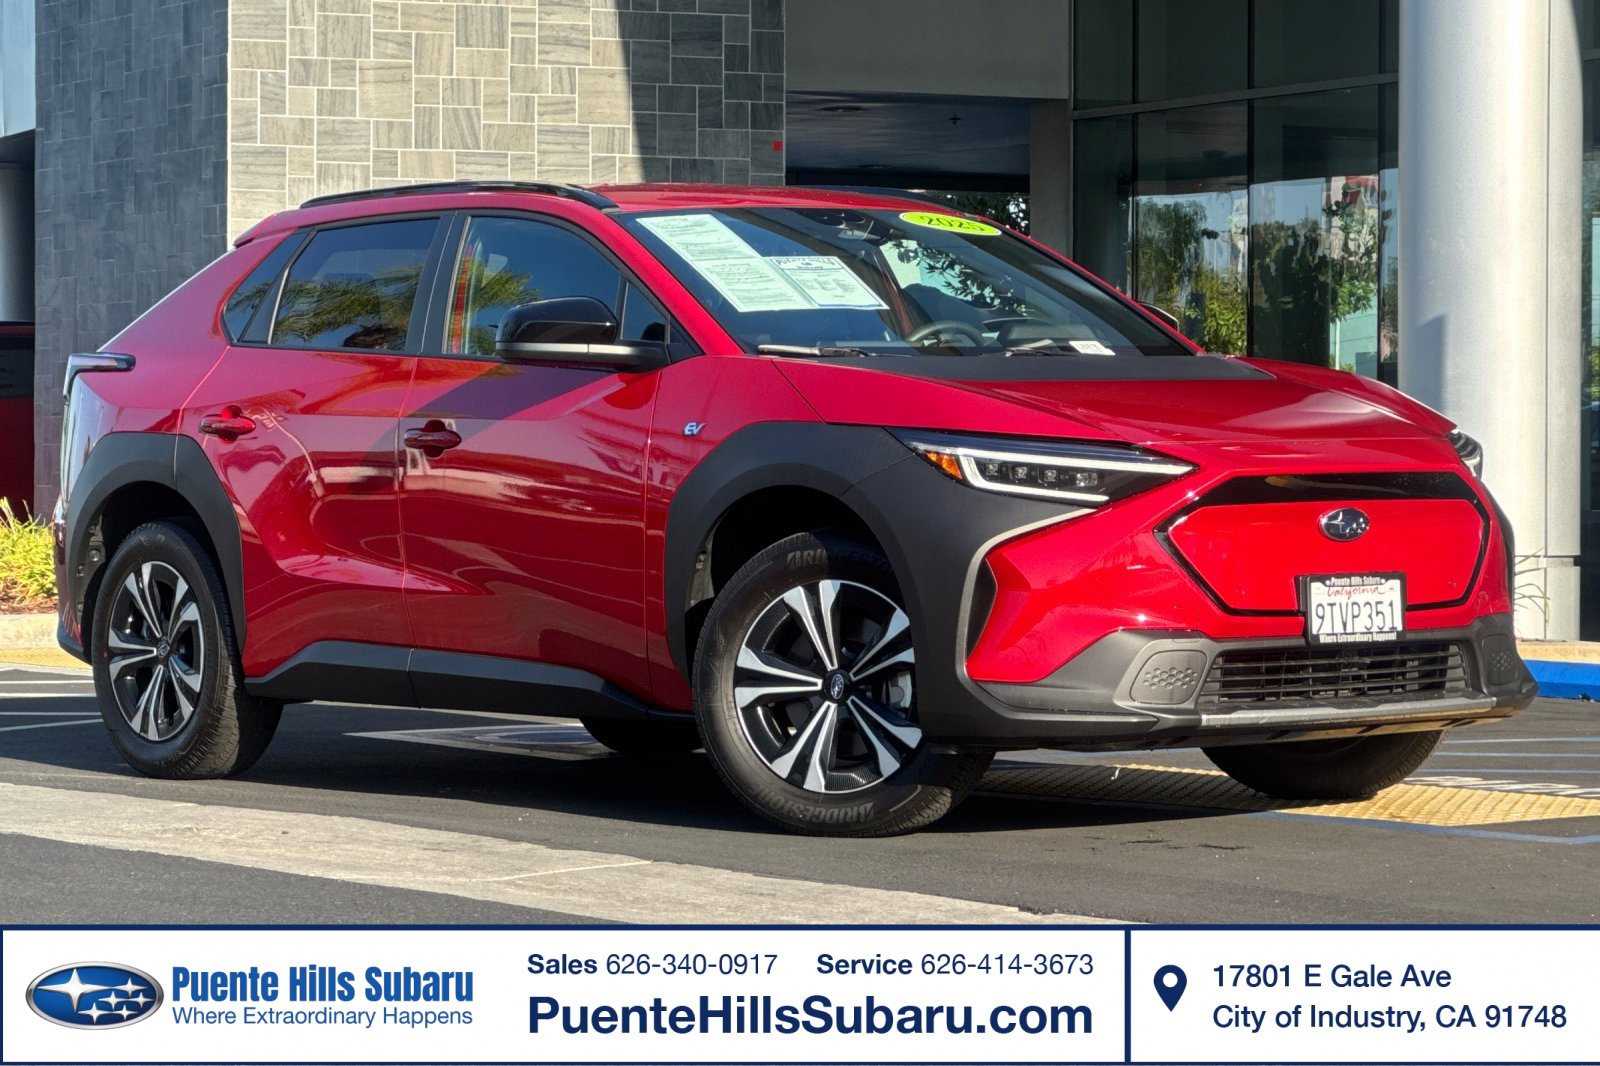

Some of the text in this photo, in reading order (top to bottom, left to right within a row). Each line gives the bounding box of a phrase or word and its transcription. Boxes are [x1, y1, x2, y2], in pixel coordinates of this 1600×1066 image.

[684, 422, 706, 436] EV
[1327, 586, 1385, 600] California
[1315, 600, 1398, 634] 9TVP351
